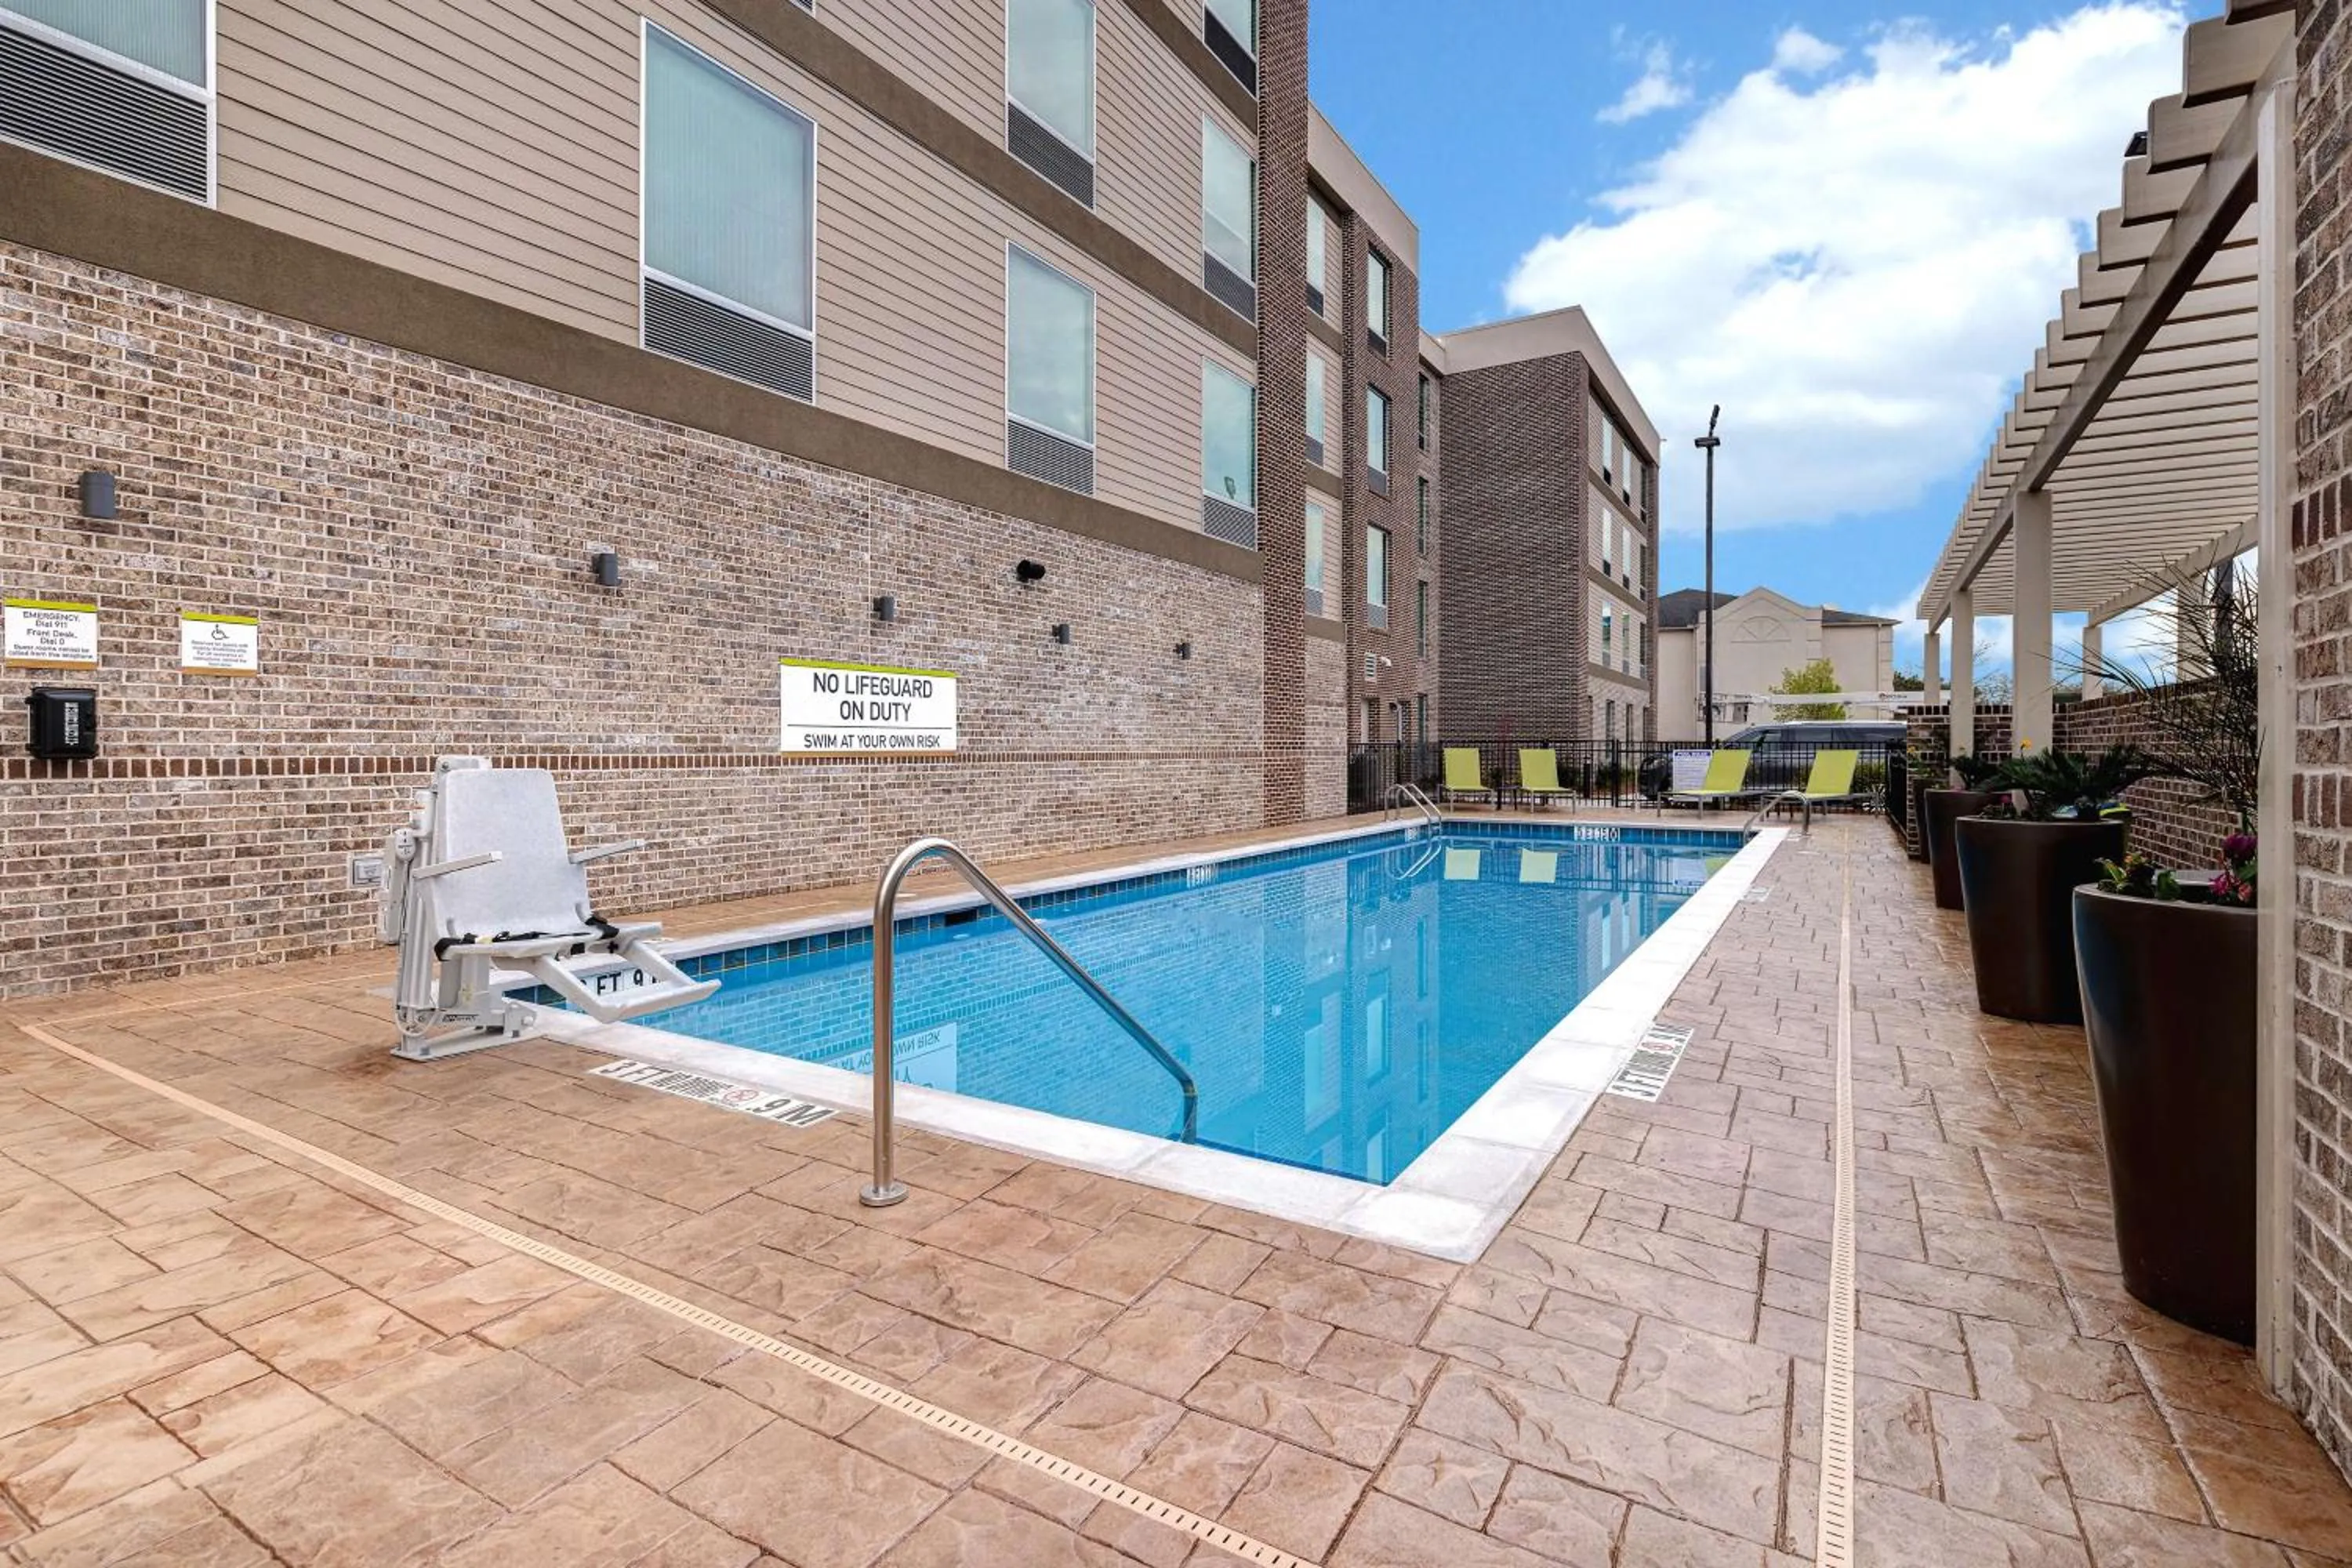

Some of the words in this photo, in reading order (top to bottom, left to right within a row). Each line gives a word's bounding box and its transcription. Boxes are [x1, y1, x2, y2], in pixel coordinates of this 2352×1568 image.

[813, 673, 839, 694] NO
[845, 673, 933, 699] LIFEGUARD
[840, 700, 863, 720] ON
[869, 702, 912, 721] DUTY
[804, 734, 837, 749] SWIM
[841, 735, 855, 749] AT
[857, 735, 887, 749] YOUR
[889, 735, 914, 748] OWN
[917, 735, 940, 747] RISK
[597, 971, 622, 996] FT
[617, 1065, 672, 1083] FT
[1616, 1070, 1664, 1089] FT
[775, 1104, 834, 1125] M
